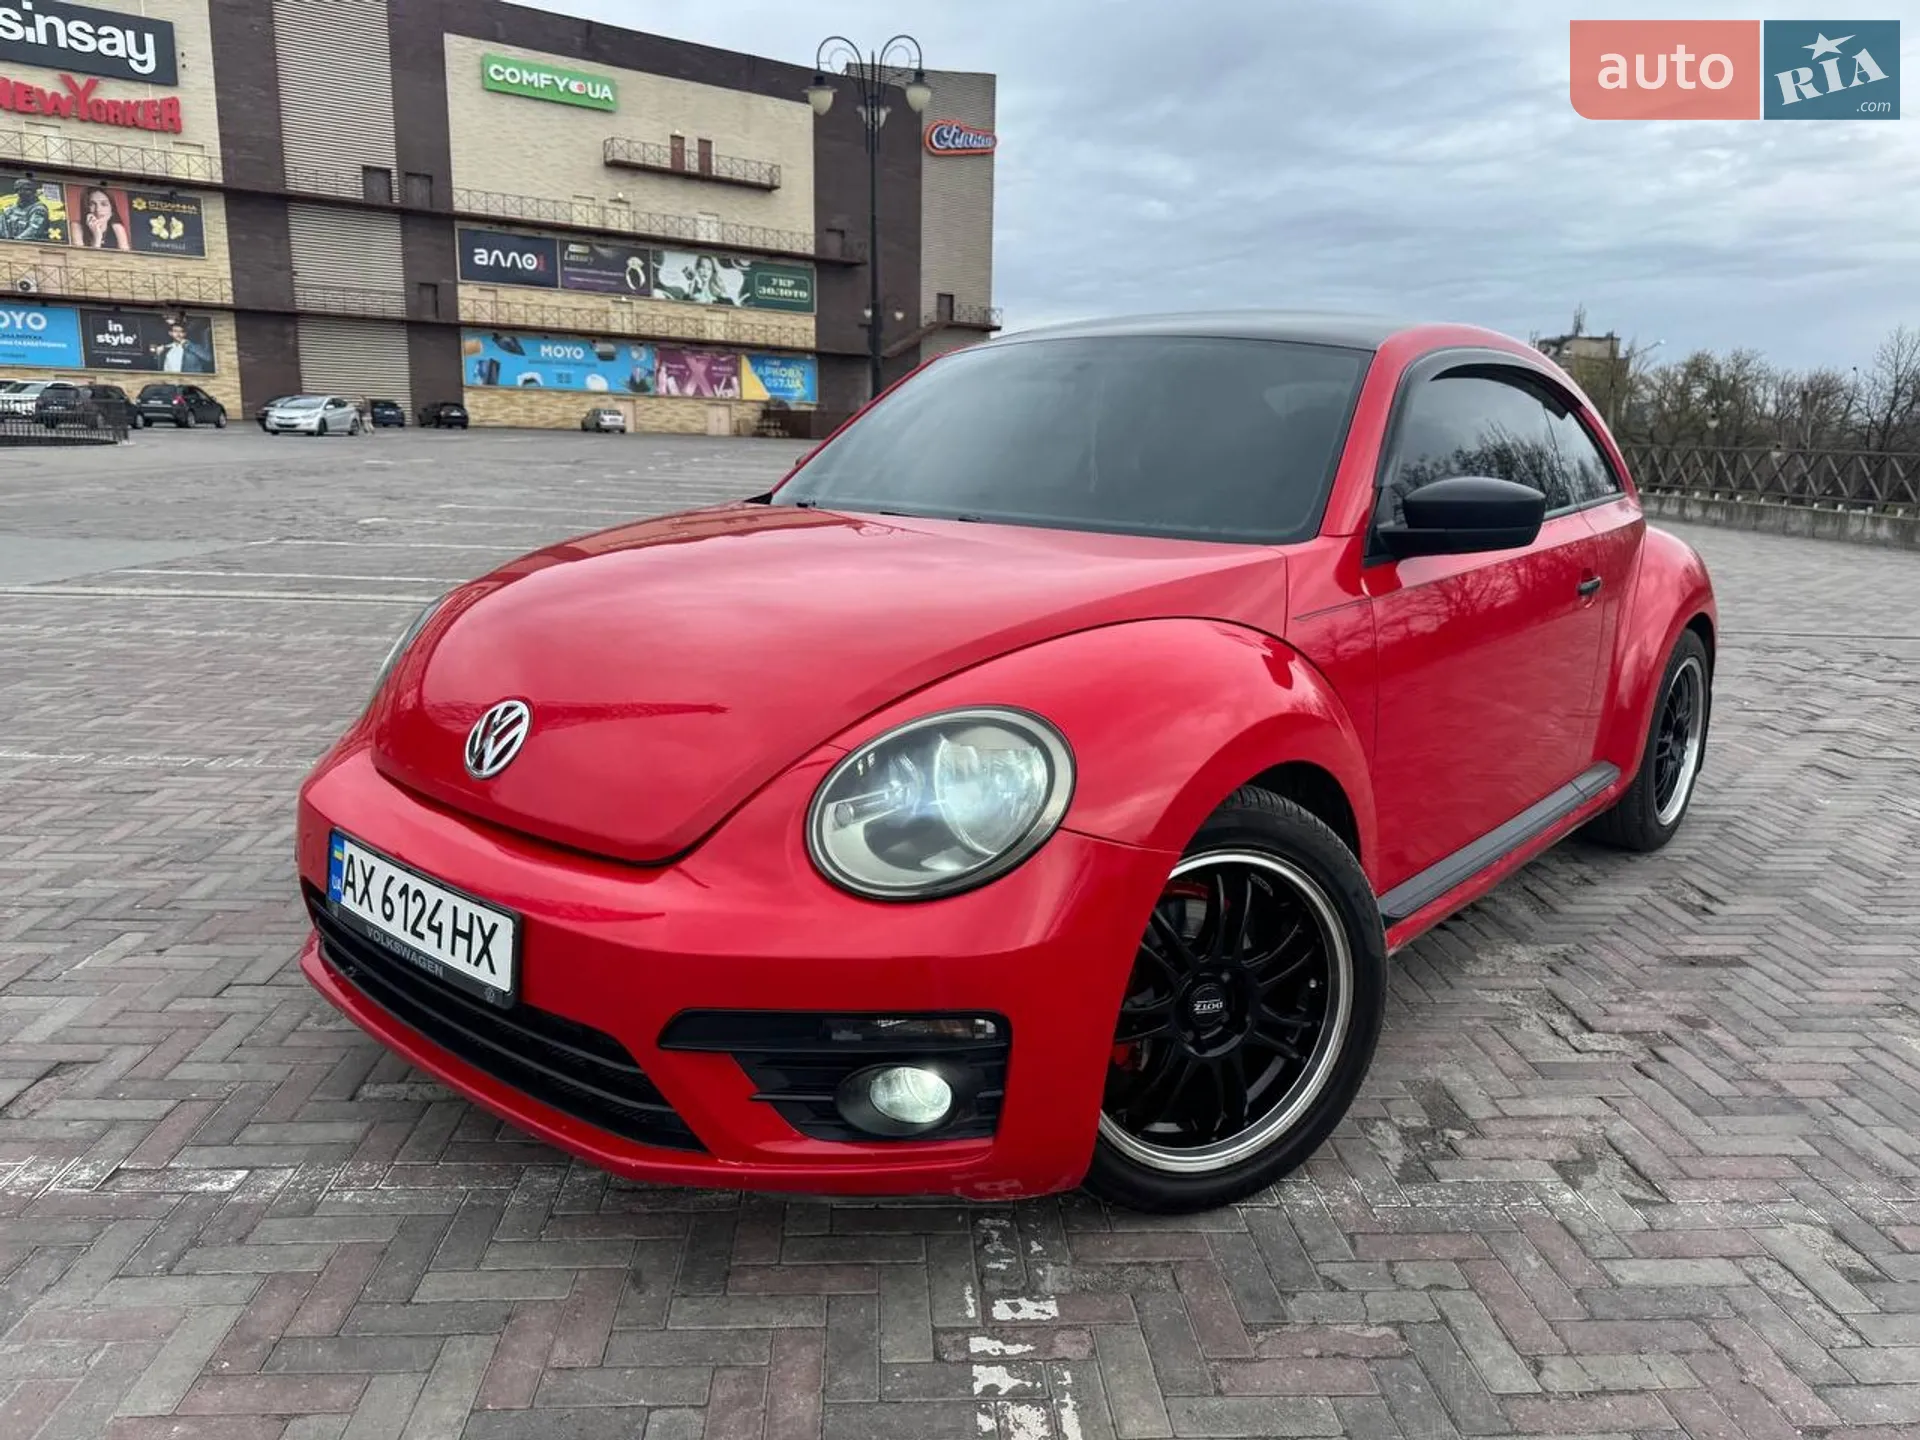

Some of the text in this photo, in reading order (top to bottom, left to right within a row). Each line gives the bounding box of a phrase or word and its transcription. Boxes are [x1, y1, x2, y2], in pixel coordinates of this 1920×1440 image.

[0, 0, 157, 75] sinsay
[108, 319, 123, 332] in
[541, 344, 585, 360] MOYO
[343, 853, 499, 975] AX 6124 HX
[366, 925, 444, 978] VOLKSWAGEN
